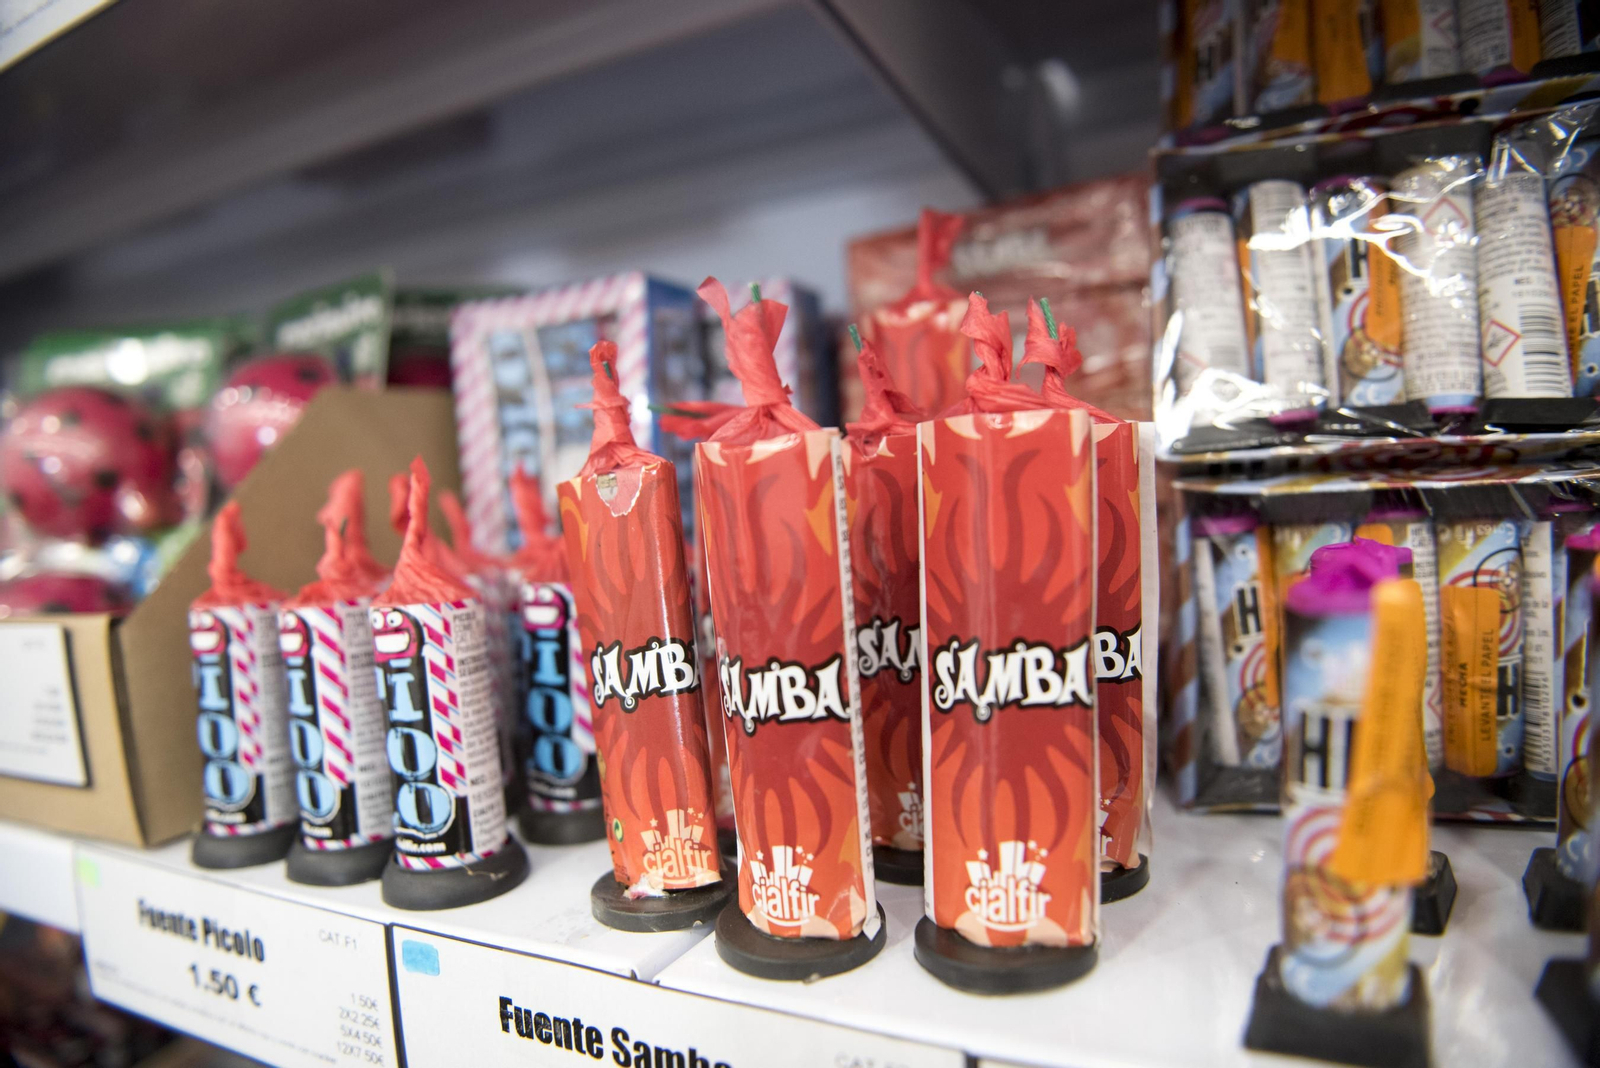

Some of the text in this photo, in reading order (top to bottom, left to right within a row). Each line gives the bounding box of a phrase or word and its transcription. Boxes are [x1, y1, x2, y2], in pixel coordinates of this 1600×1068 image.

[1571, 265, 1584, 304] PAPEL
[1483, 629, 1494, 668] PAPEL
[720, 656, 851, 733] SAMBA
[934, 640, 1093, 720] SAMBA
[1460, 662, 1468, 708] MECHA
[643, 837, 711, 879] cialfir
[752, 876, 820, 919] cialfir
[965, 875, 1051, 923] cialfir
[138, 897, 265, 962] Fuente Picolo
[189, 963, 239, 1000] 1.50
[499, 995, 604, 1061] Fuente
